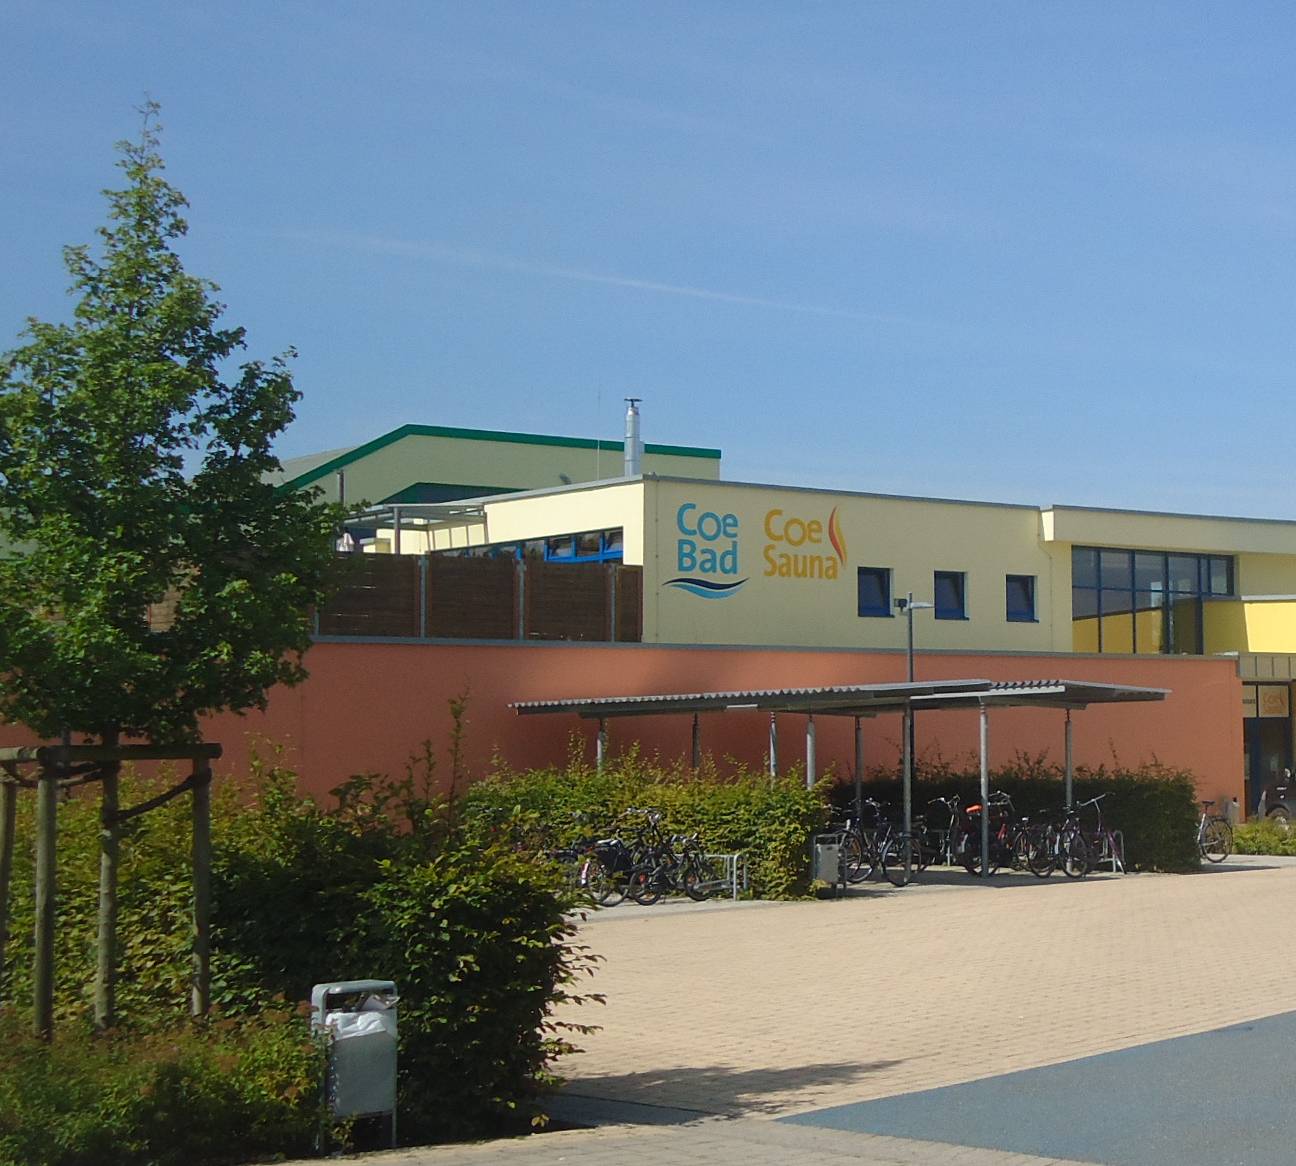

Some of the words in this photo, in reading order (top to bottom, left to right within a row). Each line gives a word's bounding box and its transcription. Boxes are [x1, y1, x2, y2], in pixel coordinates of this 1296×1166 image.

[677, 503, 738, 541] Coe
[764, 509, 822, 546] Coe
[678, 539, 738, 574] Bad
[764, 545, 838, 579] Sauna
